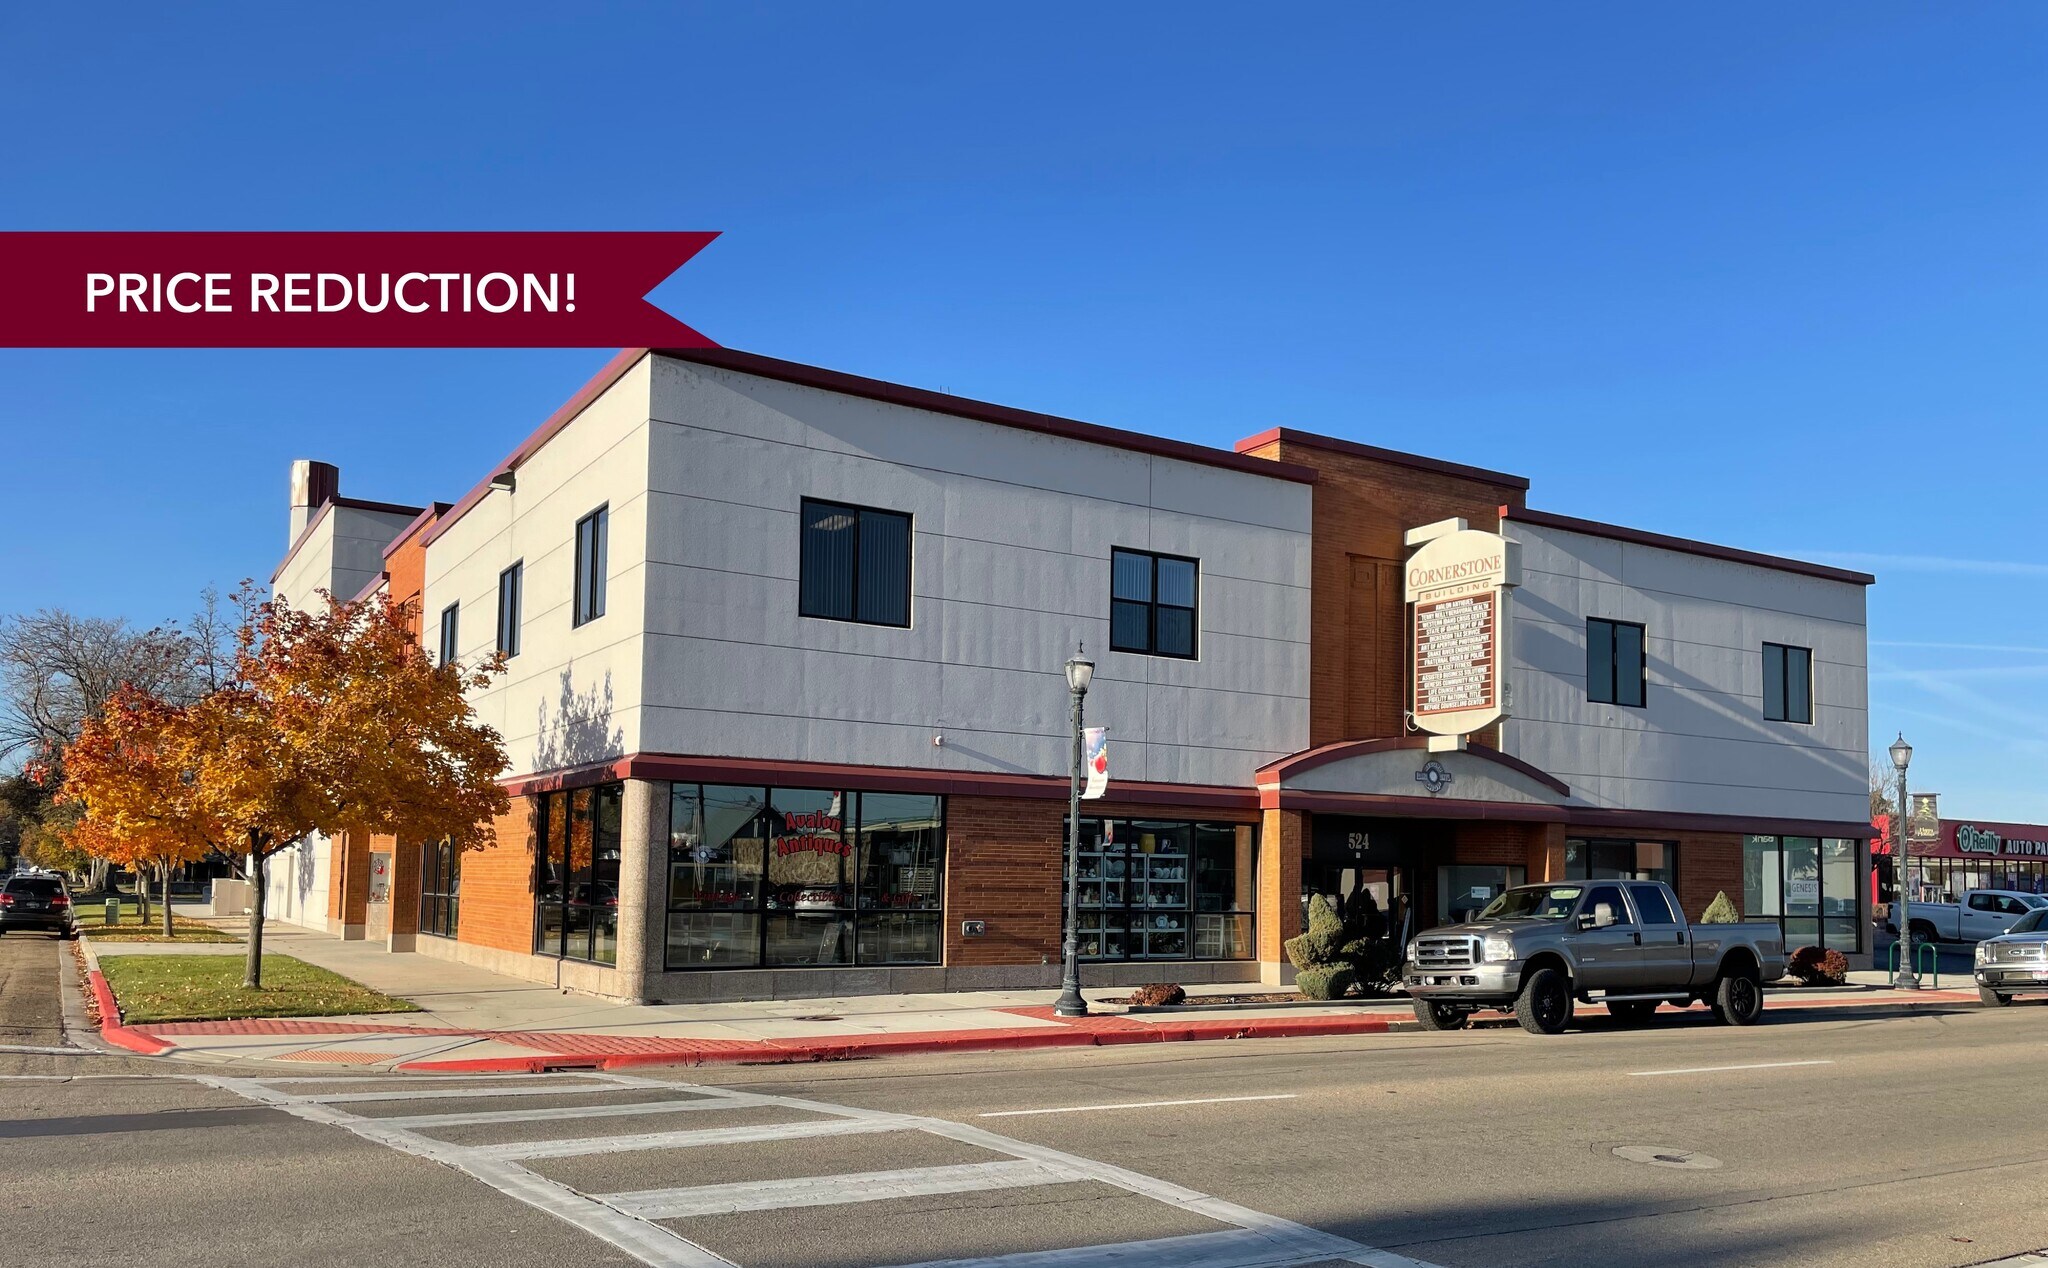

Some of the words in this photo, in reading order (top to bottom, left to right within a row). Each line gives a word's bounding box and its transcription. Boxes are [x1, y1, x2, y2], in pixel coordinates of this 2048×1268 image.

[1409, 555, 1501, 587] CORNERSTONE
[1425, 581, 1489, 600] BUILDING
[1473, 603, 1488, 611] HEALTH
[1471, 612, 1487, 620] CENTER
[1427, 627, 1440, 635] STATE
[1425, 657, 1448, 665] FRATERNAL
[1450, 654, 1463, 662] ORDER
[1470, 651, 1484, 659] POLICE
[1455, 661, 1472, 669] FITNESS
[1443, 670, 1463, 678] BUSINESS
[1464, 666, 1487, 675] SOLUTIONS
[1443, 677, 1467, 686] COMMUNITY
[1469, 674, 1485, 682] HEALTH
[1429, 695, 1446, 703] FIDELITY
[1448, 692, 1468, 700] NATIONAL
[785, 810, 842, 832] Avalon
[777, 832, 851, 857] Antiques
[1348, 832, 1369, 850] 524
[1960, 826, 2000, 855] O'Reilly
[2006, 840, 2032, 855] AUTO
[2035, 842, 2048, 855] PA
[1791, 883, 1818, 892] GENESIS
